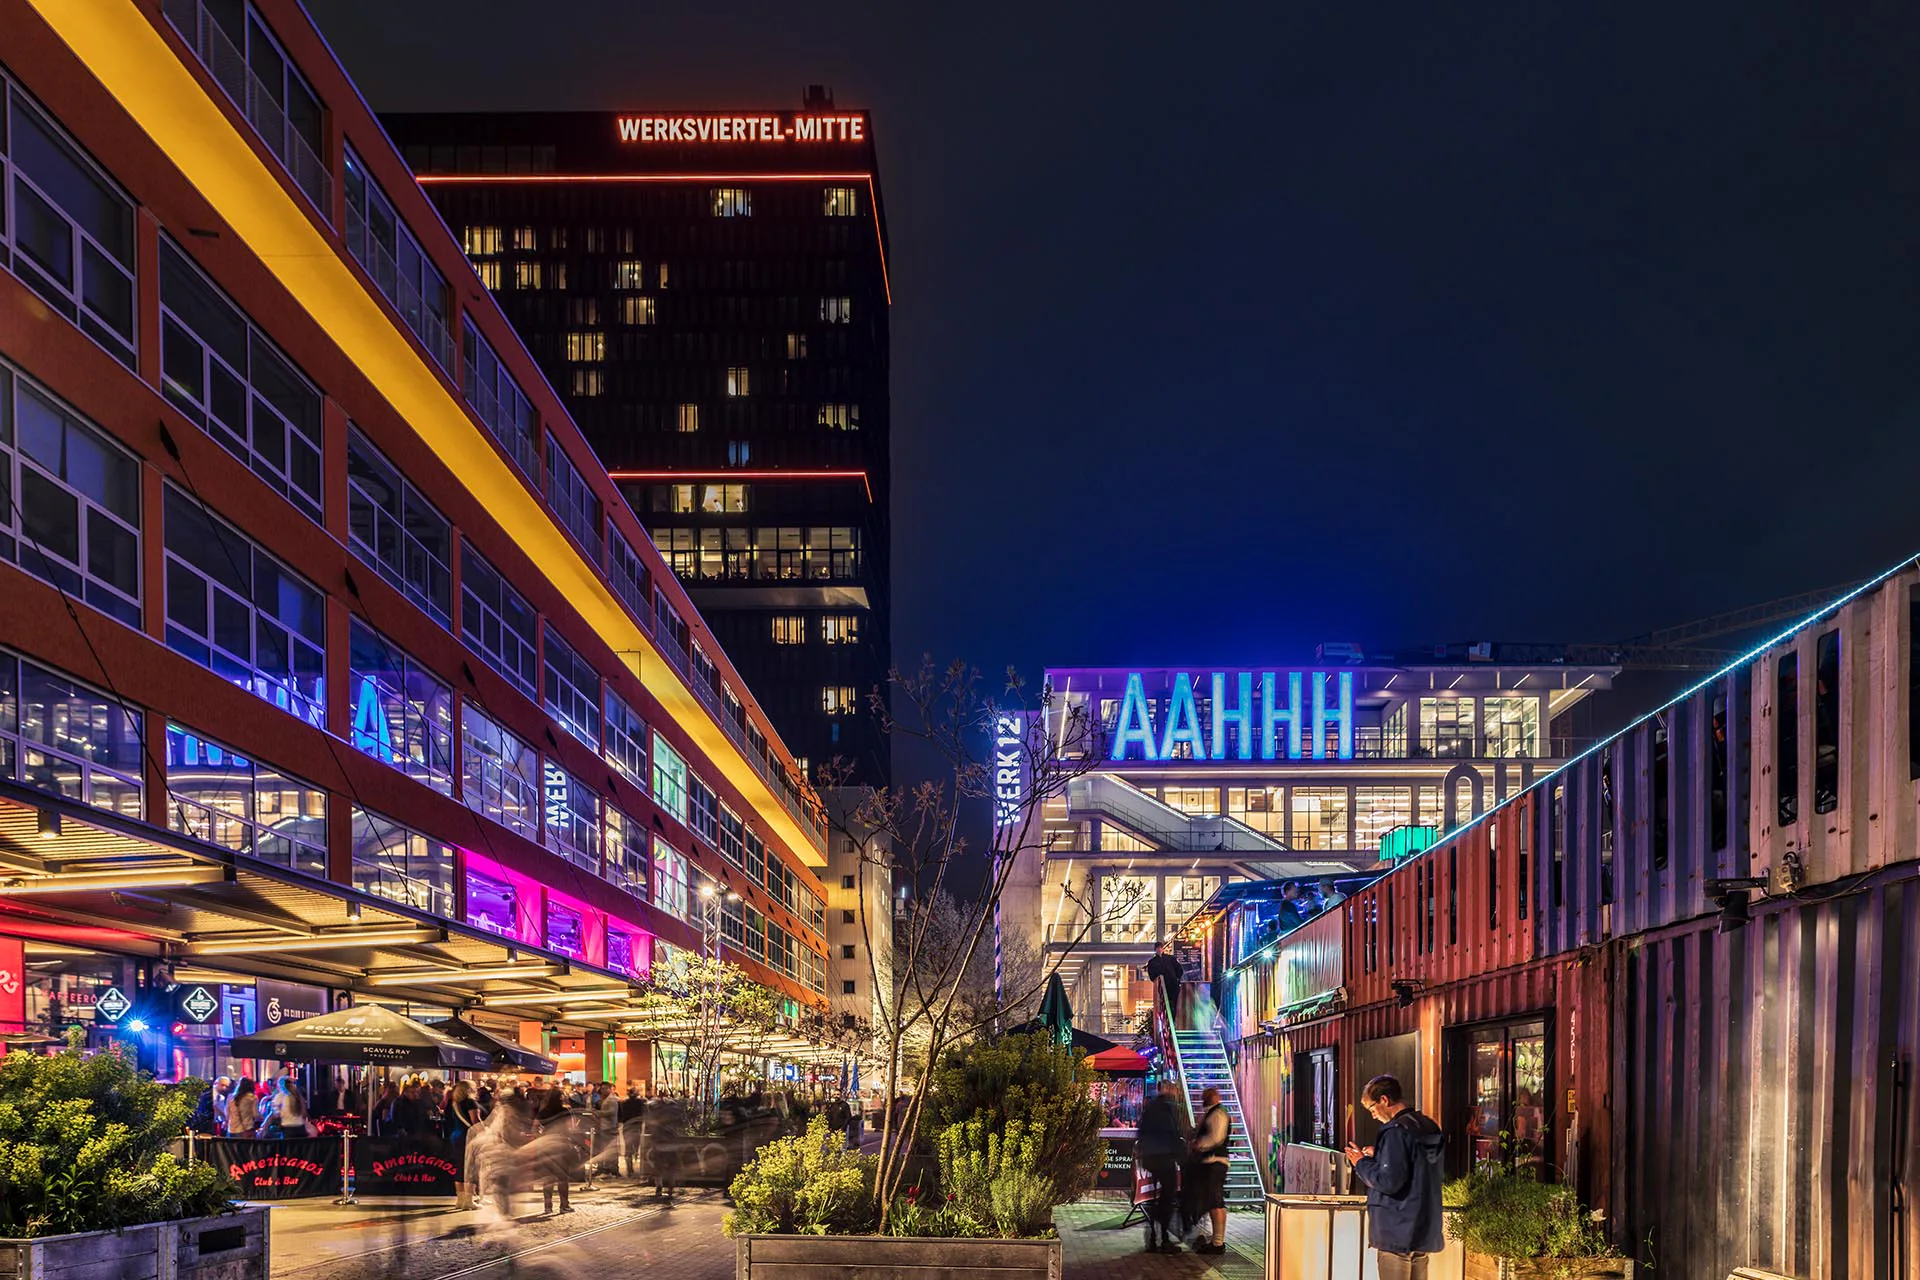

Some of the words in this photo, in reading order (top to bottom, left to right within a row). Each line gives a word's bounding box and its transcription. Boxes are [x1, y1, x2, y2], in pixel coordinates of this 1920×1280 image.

[618, 116, 863, 141] WERKSVIERTEL-MITTE
[1111, 672, 1352, 760] AAHHH
[997, 717, 1021, 827] WERK12
[230, 1153, 324, 1180] Americanos
[372, 1152, 458, 1177] Americanos
[254, 1177, 273, 1186] Club
[283, 1176, 299, 1185] Bar
[394, 1174, 412, 1183] Club
[421, 1174, 437, 1182] Bar
